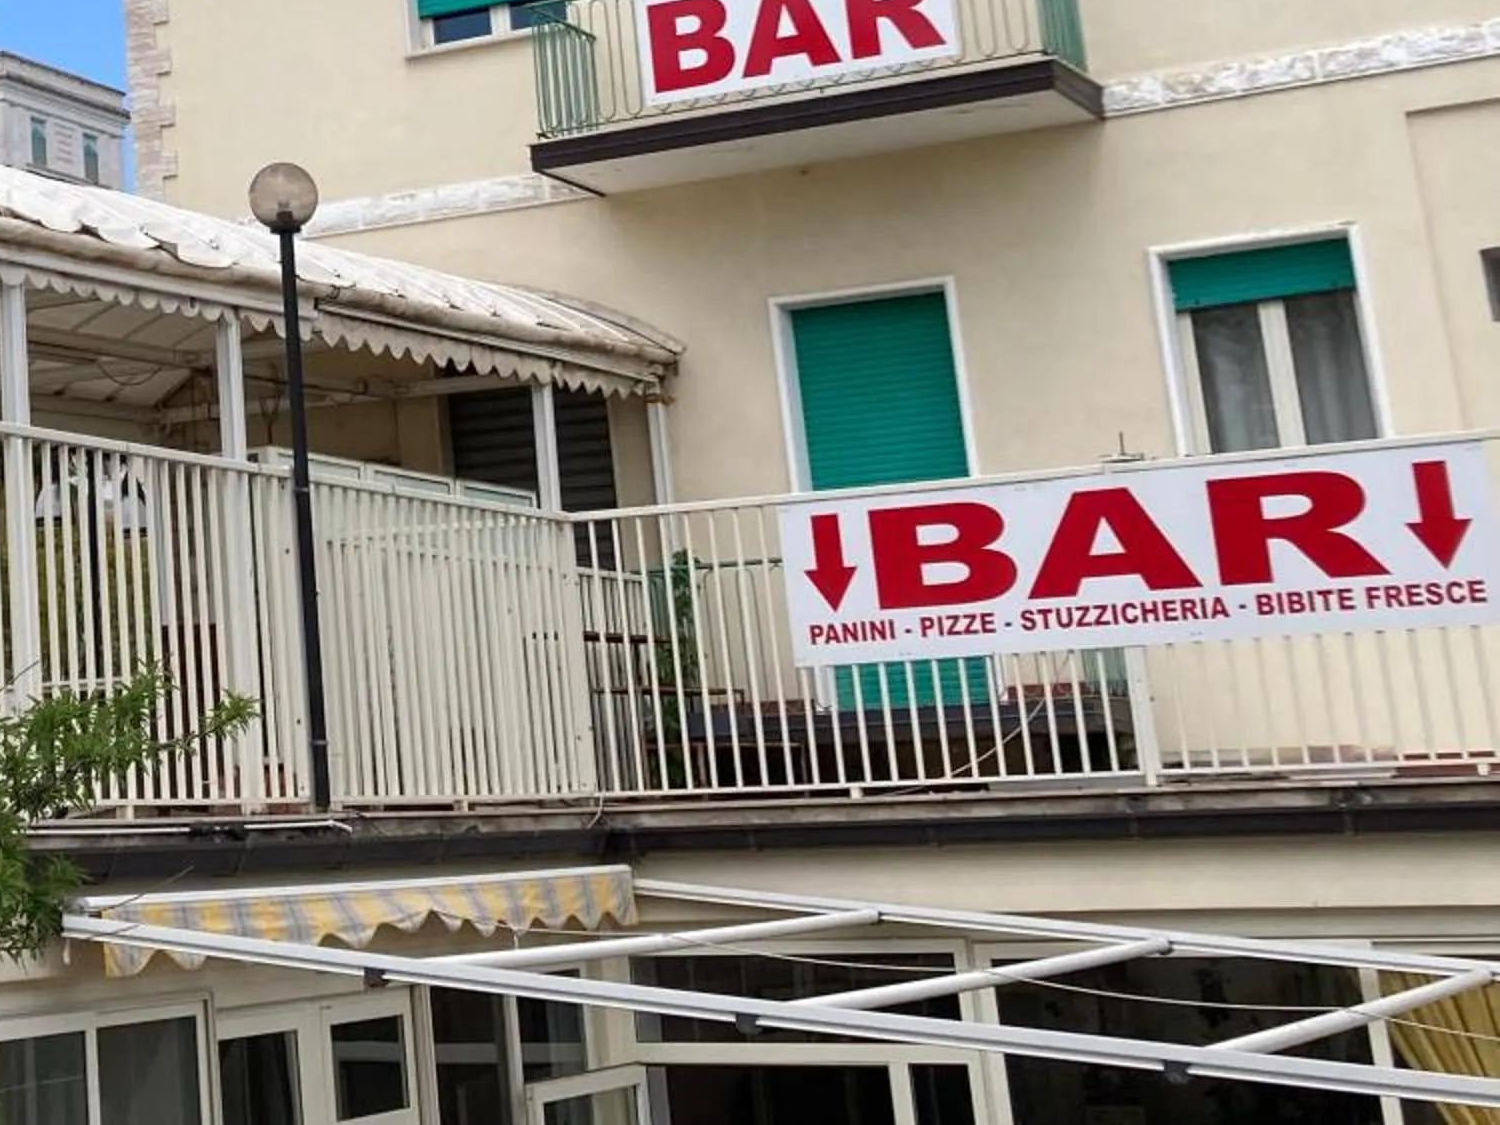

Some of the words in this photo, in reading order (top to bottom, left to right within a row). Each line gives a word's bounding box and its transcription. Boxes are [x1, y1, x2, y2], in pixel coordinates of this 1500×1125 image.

[867, 470, 1392, 611] BAR
[808, 618, 897, 646] PANINI
[919, 611, 997, 638] PIZZE
[1019, 595, 1231, 632] STUZZICHERIA
[1255, 587, 1357, 617] BIBITE
[1365, 579, 1488, 610] FRESCE
